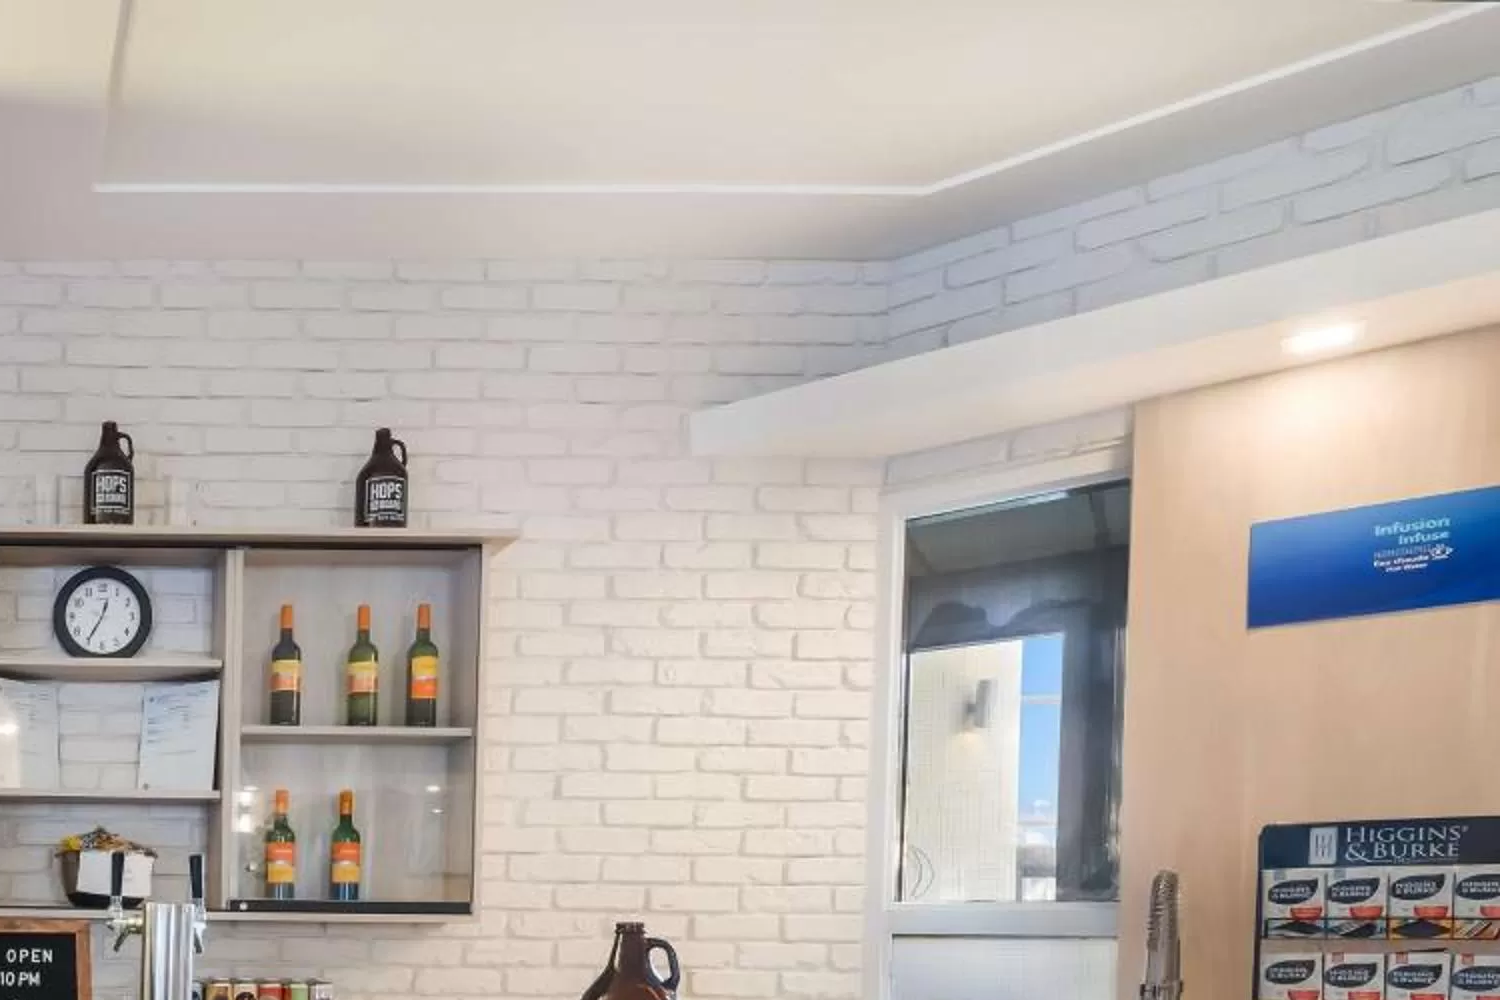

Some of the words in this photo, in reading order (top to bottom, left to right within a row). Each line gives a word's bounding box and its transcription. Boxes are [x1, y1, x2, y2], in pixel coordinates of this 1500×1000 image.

[370, 482, 403, 499] HOPS
[1374, 518, 1451, 537] Infusion
[1398, 531, 1450, 545] Infuse
[1347, 825, 1462, 843] HIGGINS
[1373, 843, 1461, 859] BURKE
[6, 948, 53, 964] OPEN
